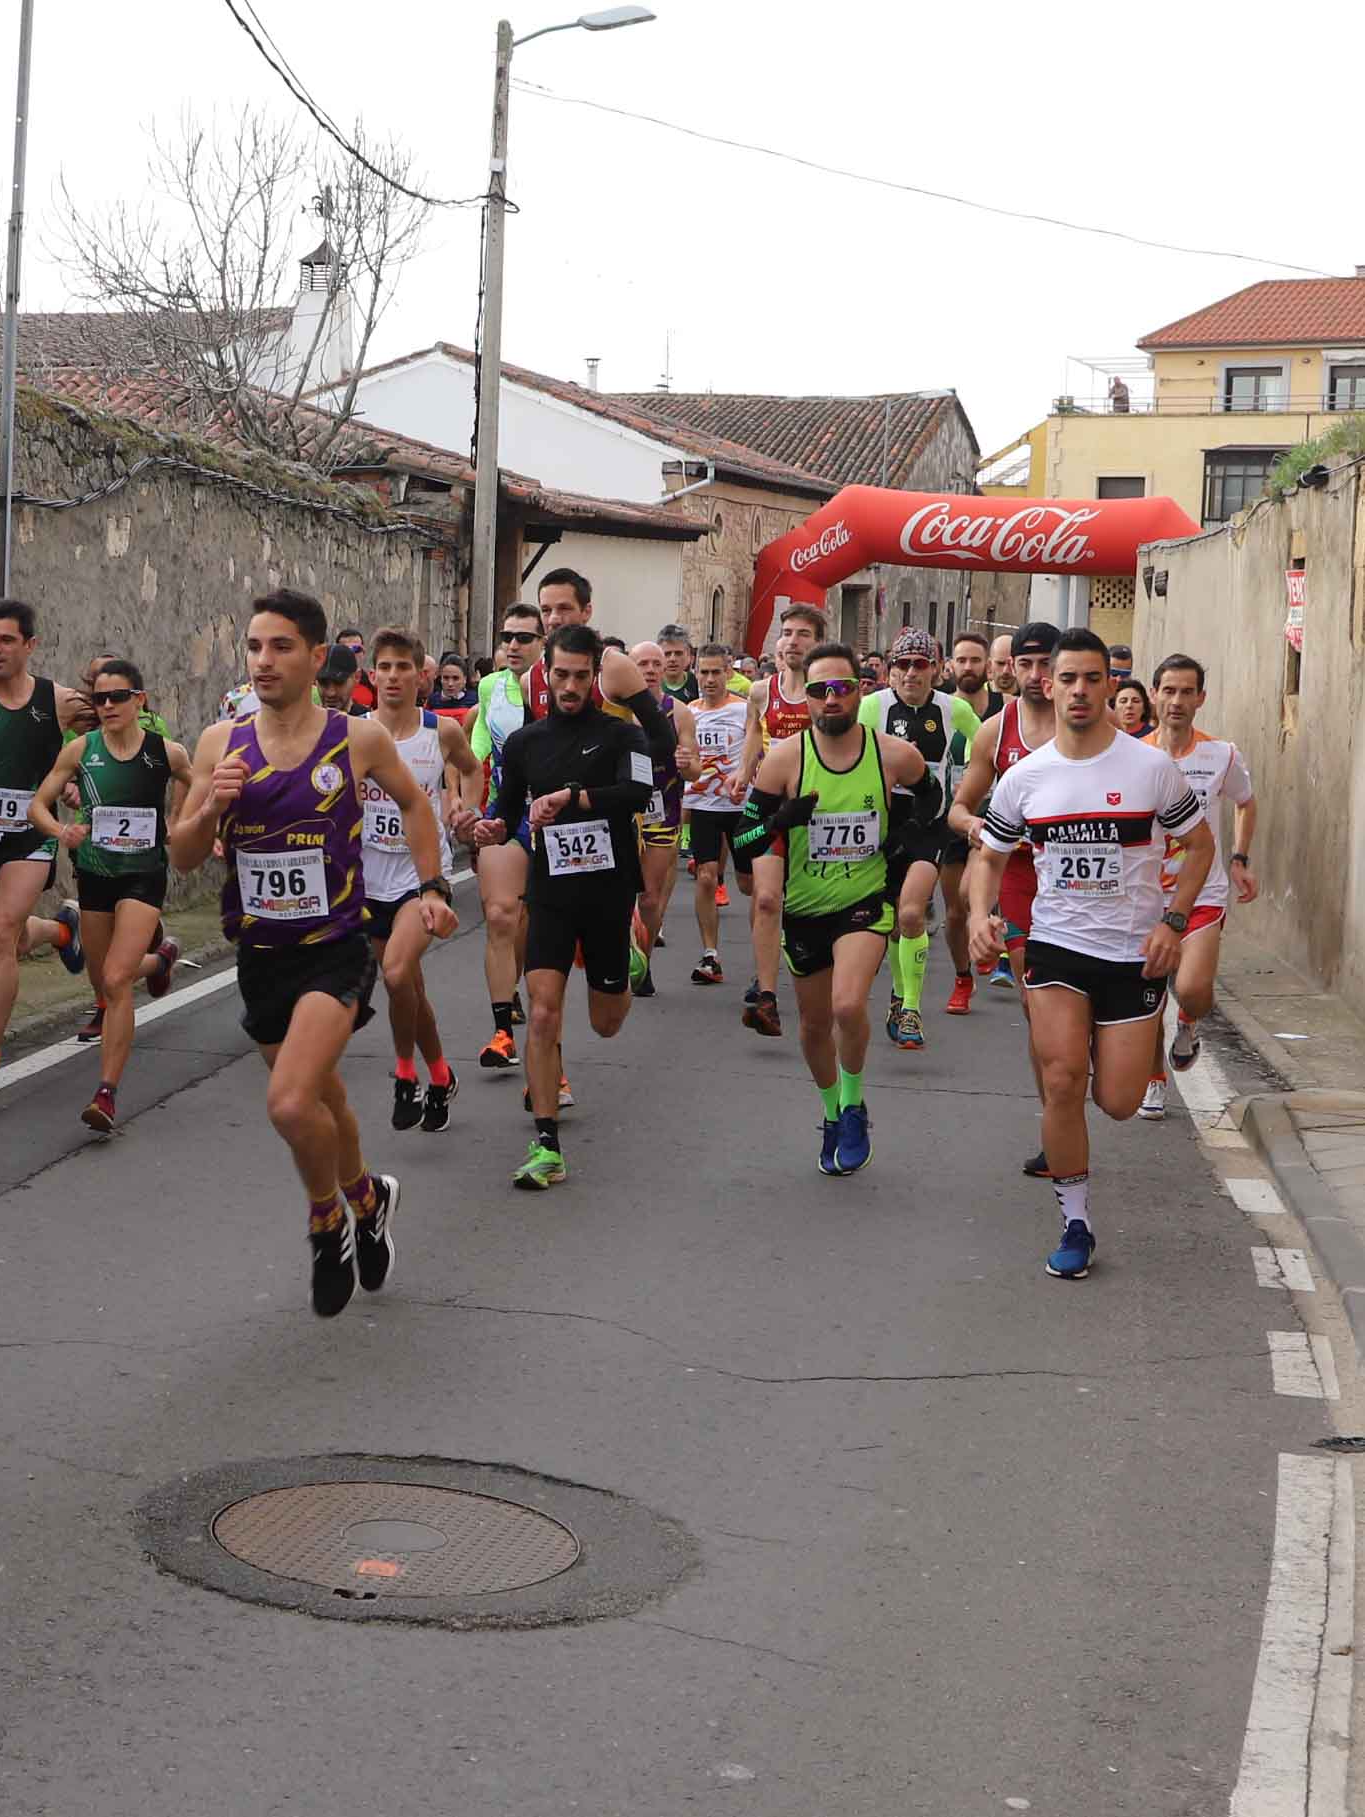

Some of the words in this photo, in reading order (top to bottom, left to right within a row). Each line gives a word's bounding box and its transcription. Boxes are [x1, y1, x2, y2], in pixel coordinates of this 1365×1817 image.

[900, 503, 1102, 564] Coca-Cola
[790, 520, 853, 572] Coca-Cola
[698, 732, 719, 745] 161
[119, 819, 130, 837] 2
[376, 815, 405, 836] 56
[823, 825, 865, 845] 776
[1047, 822, 1119, 843] CANALLA
[286, 833, 326, 846] PRIM
[558, 834, 597, 857] 542
[1060, 857, 1106, 879] 267
[250, 868, 306, 898] 796
